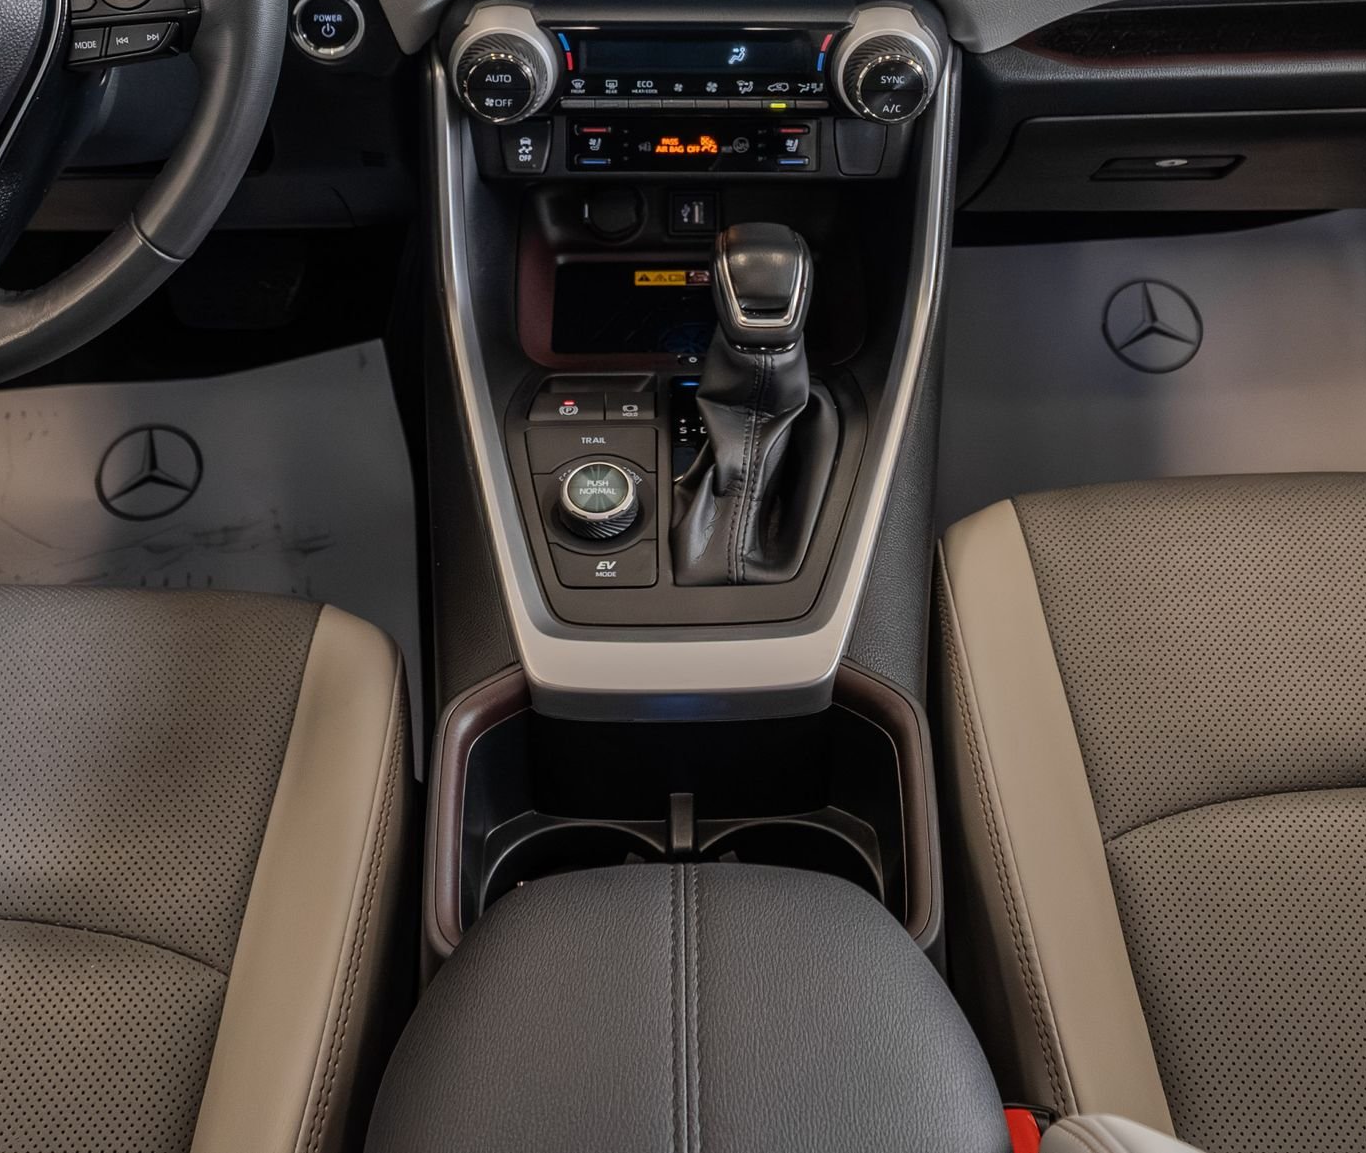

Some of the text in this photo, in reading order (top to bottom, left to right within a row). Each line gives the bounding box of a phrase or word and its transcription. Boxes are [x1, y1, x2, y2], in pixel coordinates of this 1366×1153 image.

[313, 14, 343, 22] POWER
[74, 41, 97, 49] MODE
[485, 74, 512, 83] AUTO
[880, 76, 905, 84] SYNC
[636, 80, 654, 88] ECO
[495, 99, 513, 107] OFF
[882, 104, 901, 114] A/C
[669, 145, 684, 153] BAG
[687, 145, 700, 153] OFF
[518, 154, 532, 162] OFF
[586, 479, 609, 487] PUSH
[579, 487, 617, 495] NORMAL
[596, 561, 617, 570] EV
